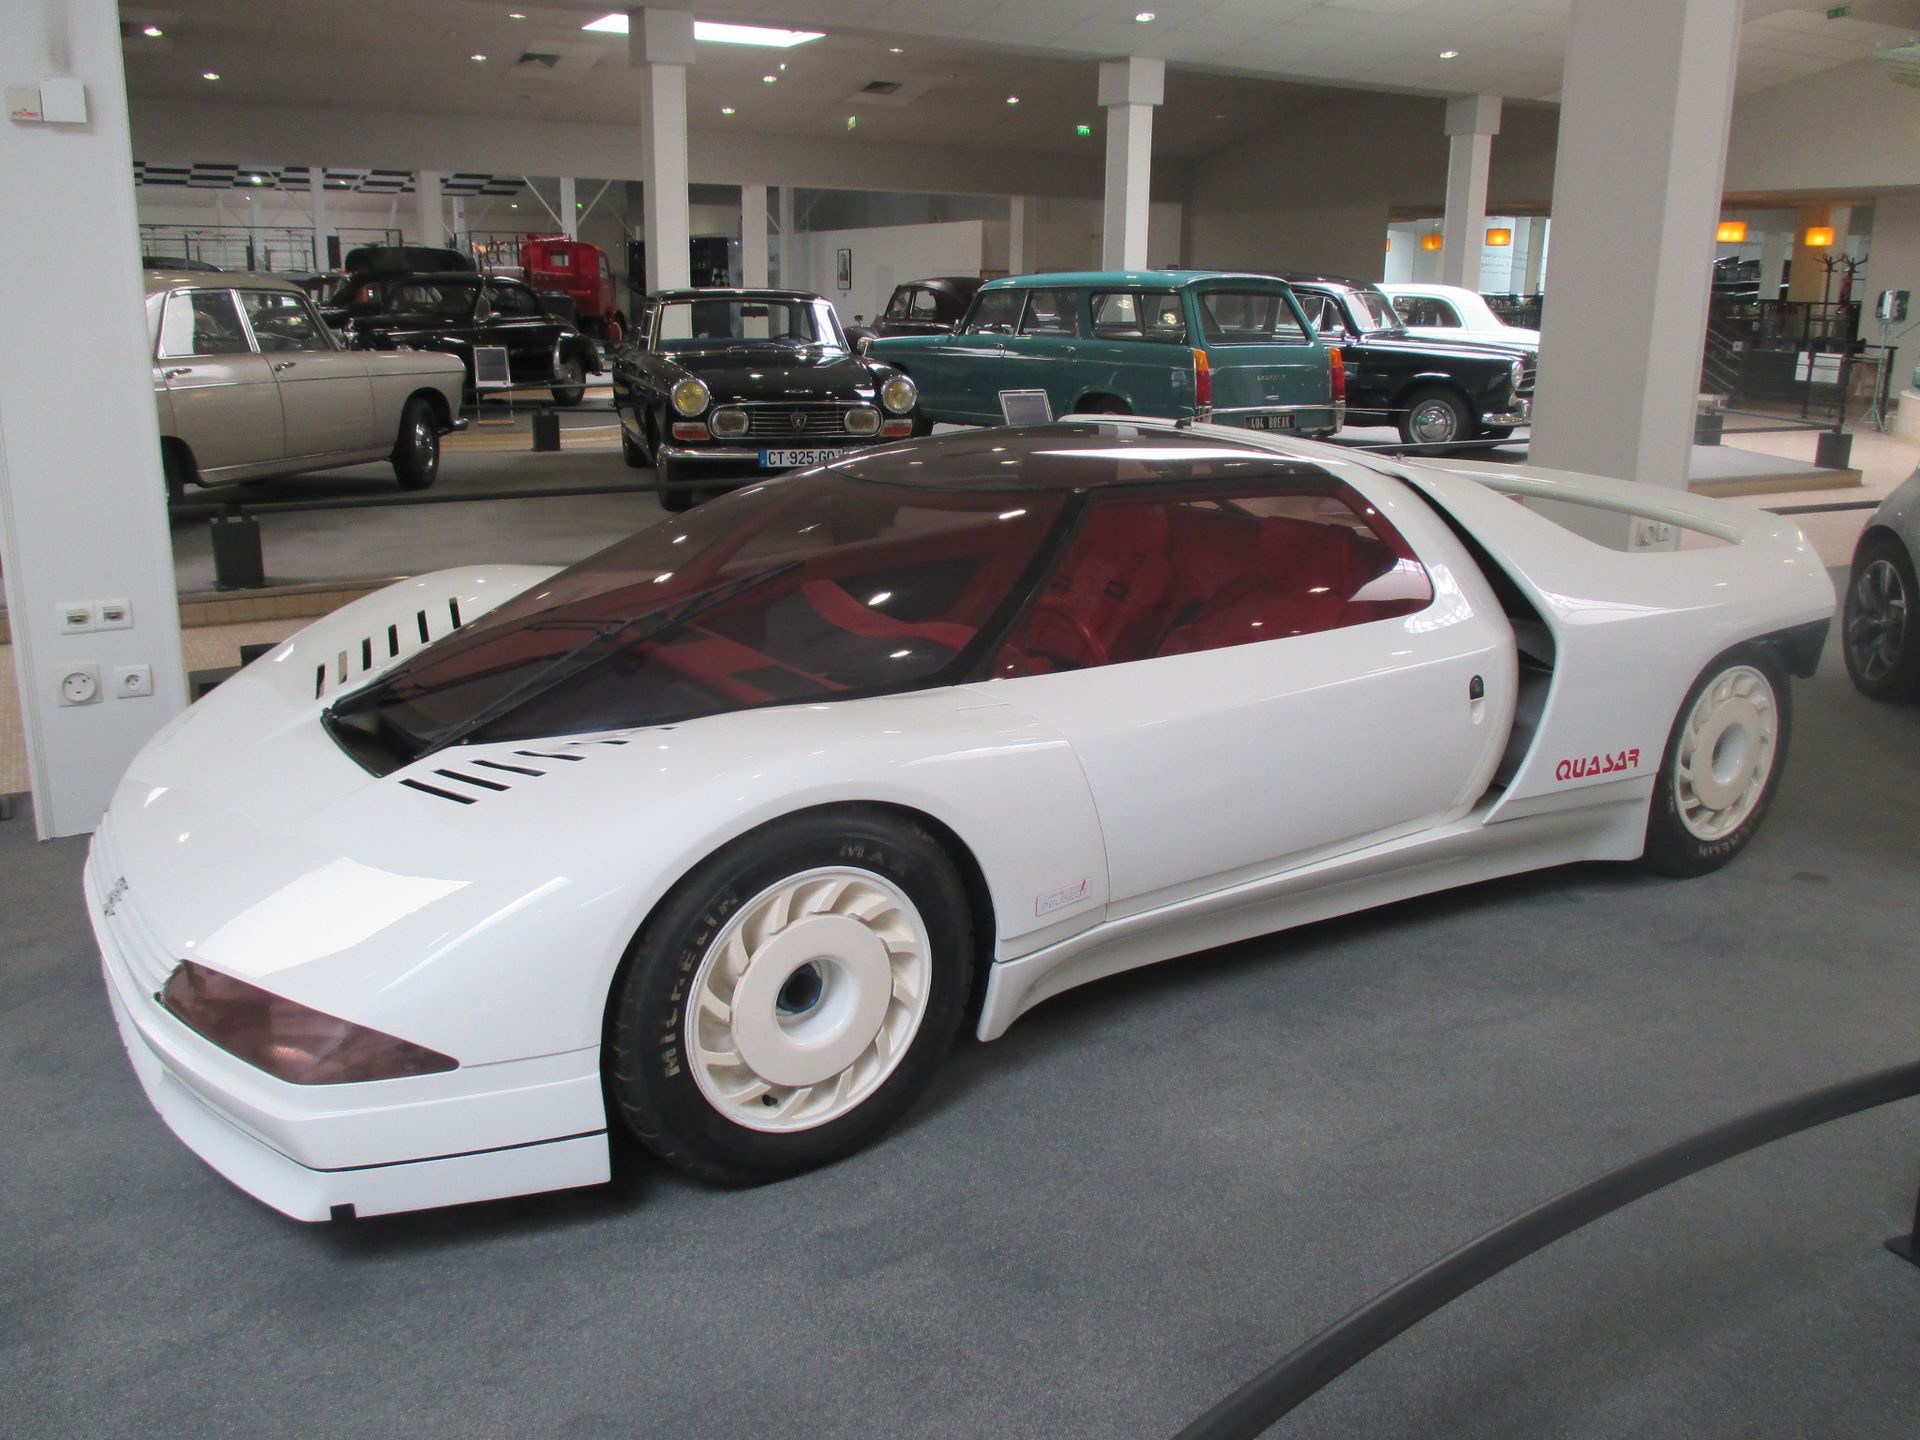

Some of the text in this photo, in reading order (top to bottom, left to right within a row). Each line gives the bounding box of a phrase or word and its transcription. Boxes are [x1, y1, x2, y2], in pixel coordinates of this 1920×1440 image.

[1250, 415, 1290, 430] 404 BREAK
[1555, 748, 1640, 781] QUASAR
